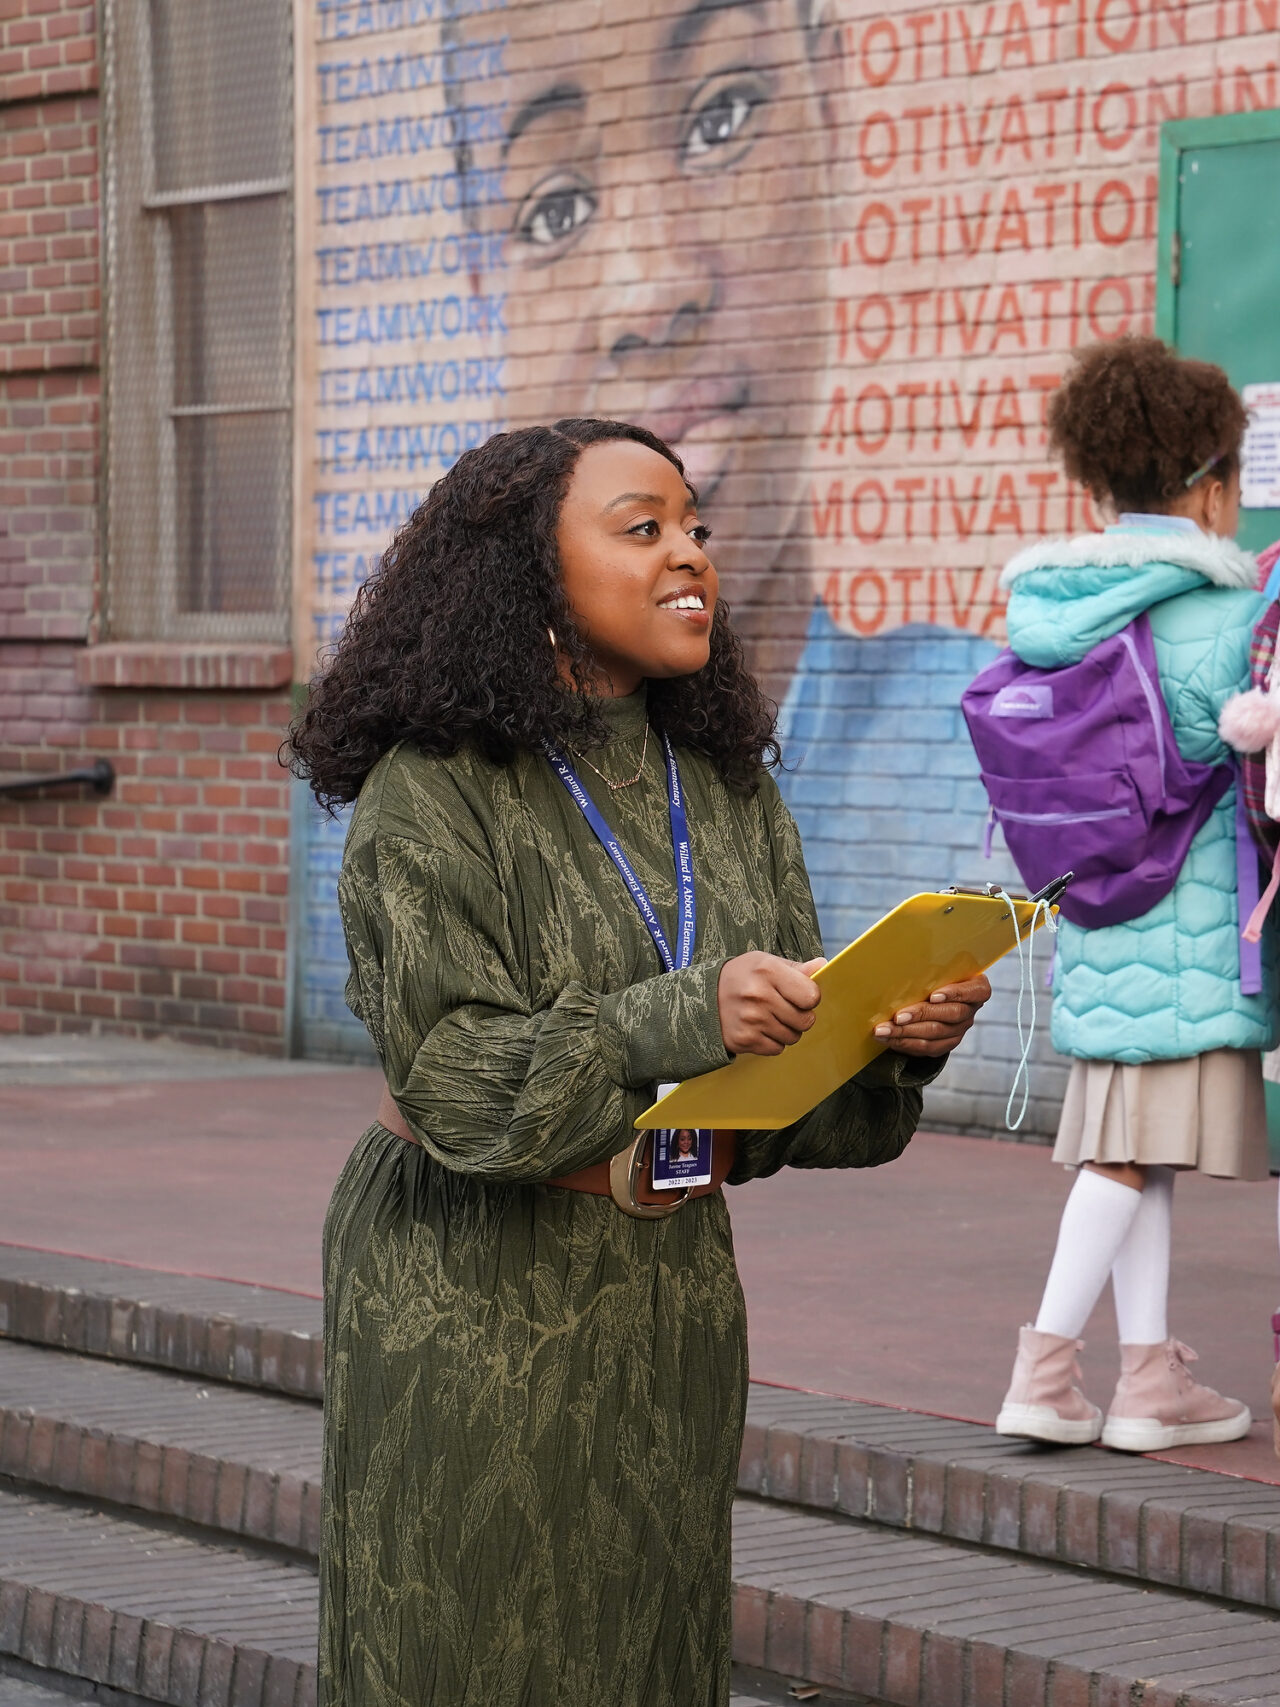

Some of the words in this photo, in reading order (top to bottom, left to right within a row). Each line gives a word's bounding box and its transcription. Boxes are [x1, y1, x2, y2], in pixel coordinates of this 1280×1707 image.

[317, 34, 509, 105] TEAMWORK
[317, 101, 508, 165] TEAMWORK
[316, 165, 508, 226] TEAMWORK
[315, 229, 508, 287] TEAMWORK
[316, 291, 509, 347] TEAMWORK
[319, 355, 508, 408] TEAMWORK
[563, 774, 588, 808] Willard
[607, 840, 640, 892] Elementary
[679, 841, 691, 873] Willard
[682, 874, 692, 885] R.
[636, 892, 657, 925] Abbott
[683, 886, 694, 919] Abbott
[681, 920, 694, 969] Elementa
